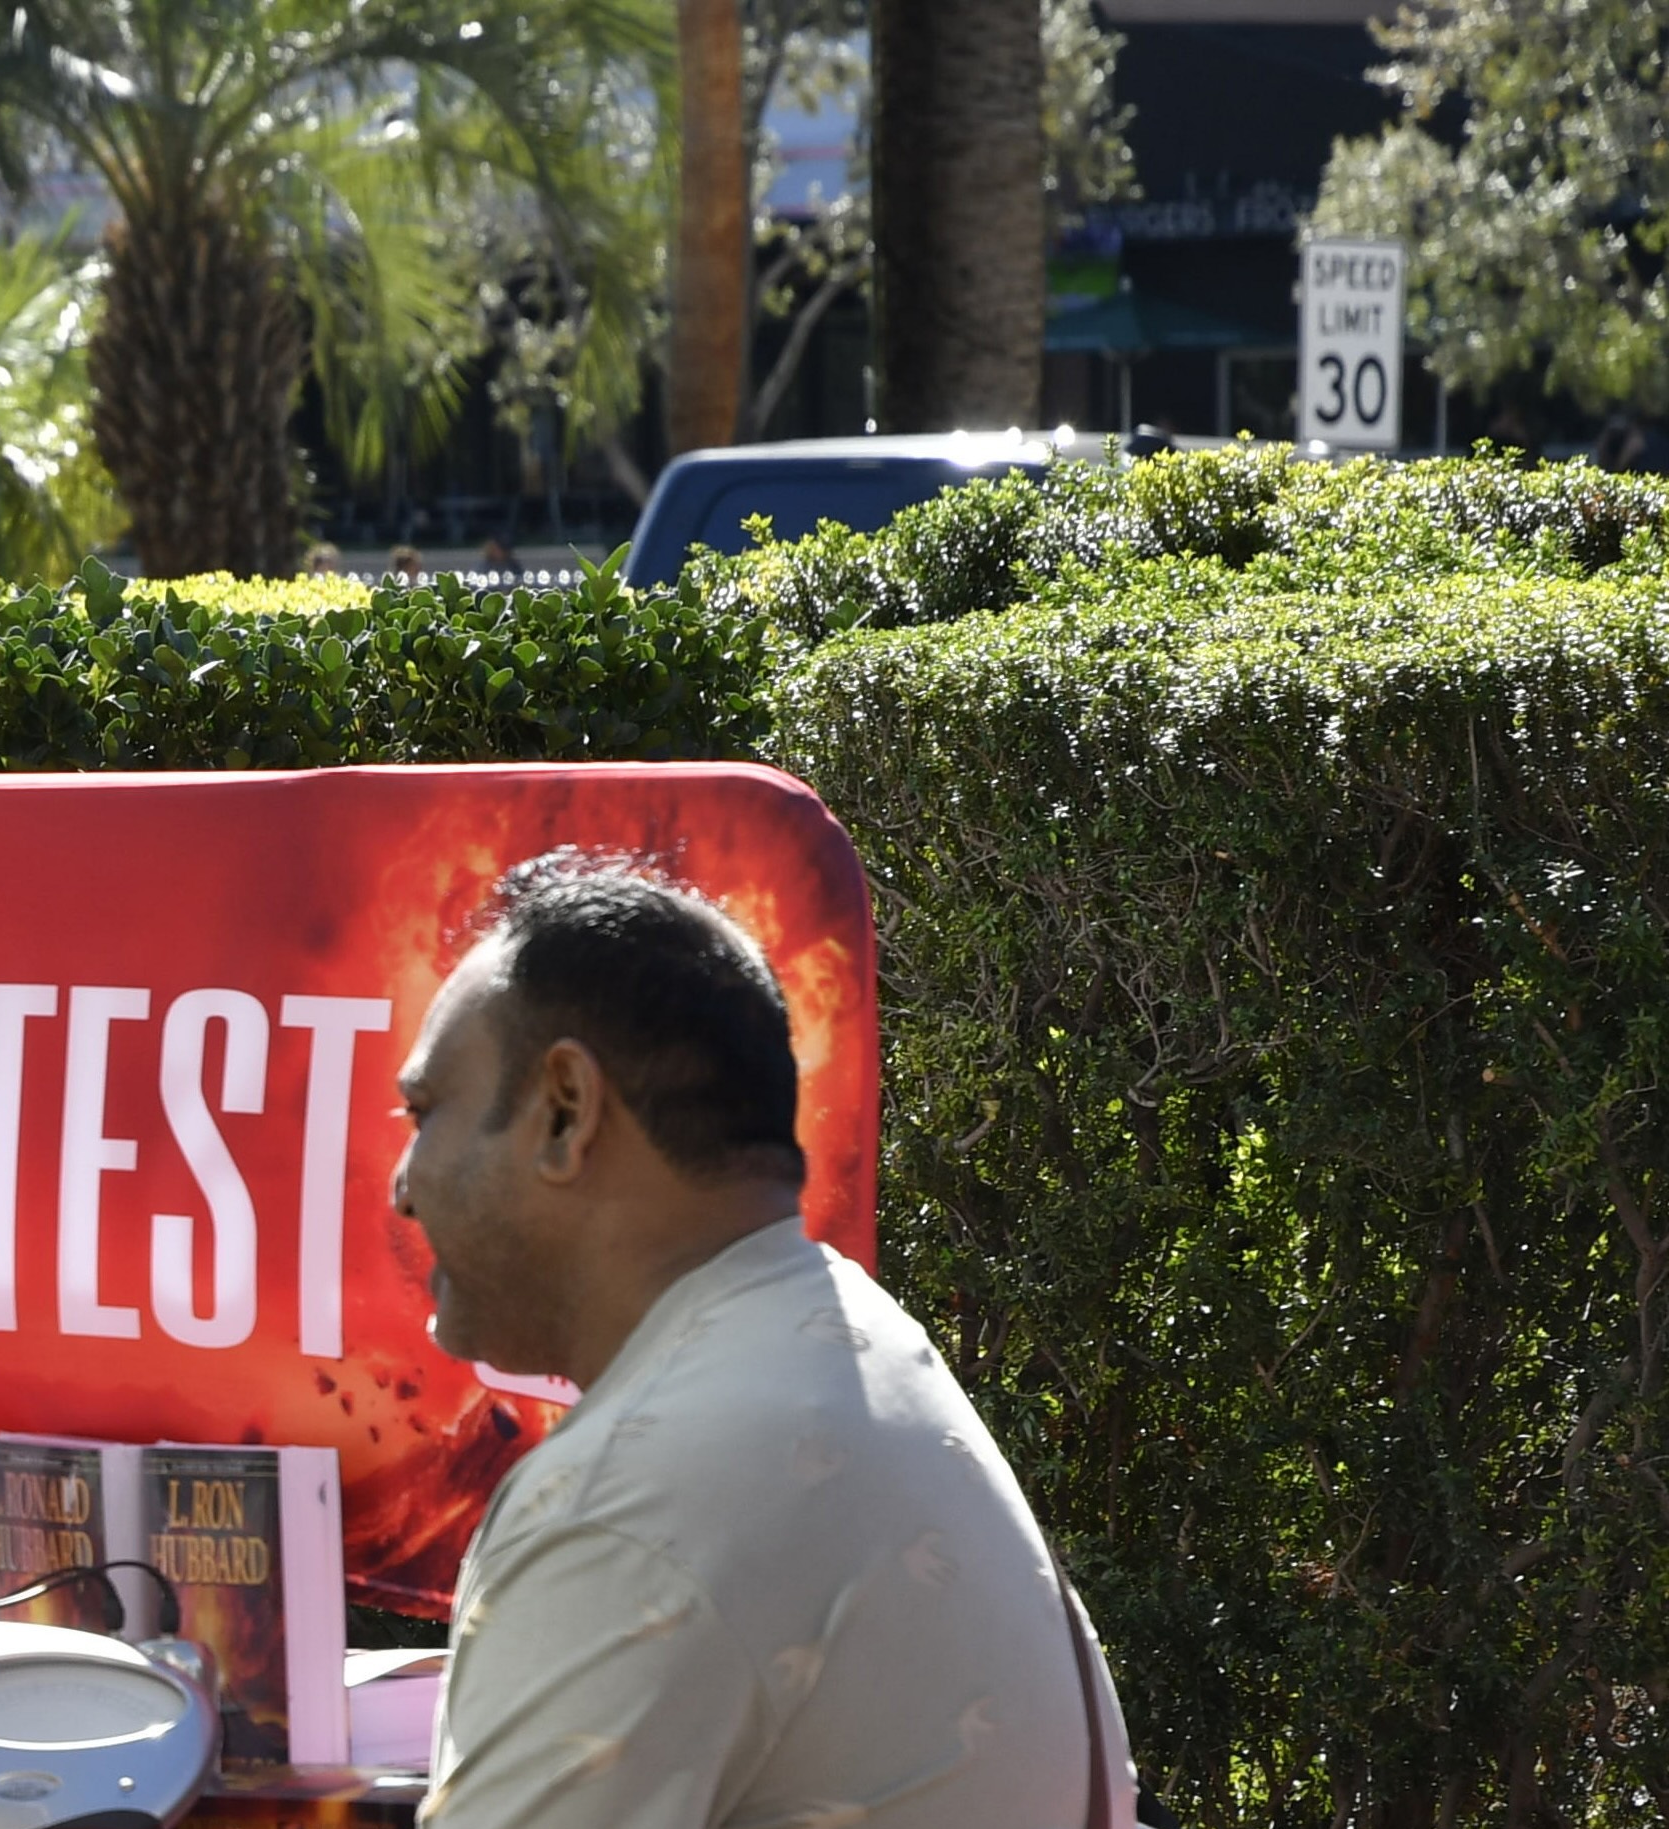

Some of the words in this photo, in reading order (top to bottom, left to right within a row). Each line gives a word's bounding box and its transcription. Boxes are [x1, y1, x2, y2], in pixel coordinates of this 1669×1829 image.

[1314, 253, 1396, 291] SPEED
[1318, 303, 1382, 336] LIMIT
[1314, 353, 1387, 426] 30
[5, 1472, 90, 1525] RONALD
[168, 1480, 189, 1528] L.
[192, 1481, 245, 1529] RON
[151, 1534, 270, 1585] HUBBARD
